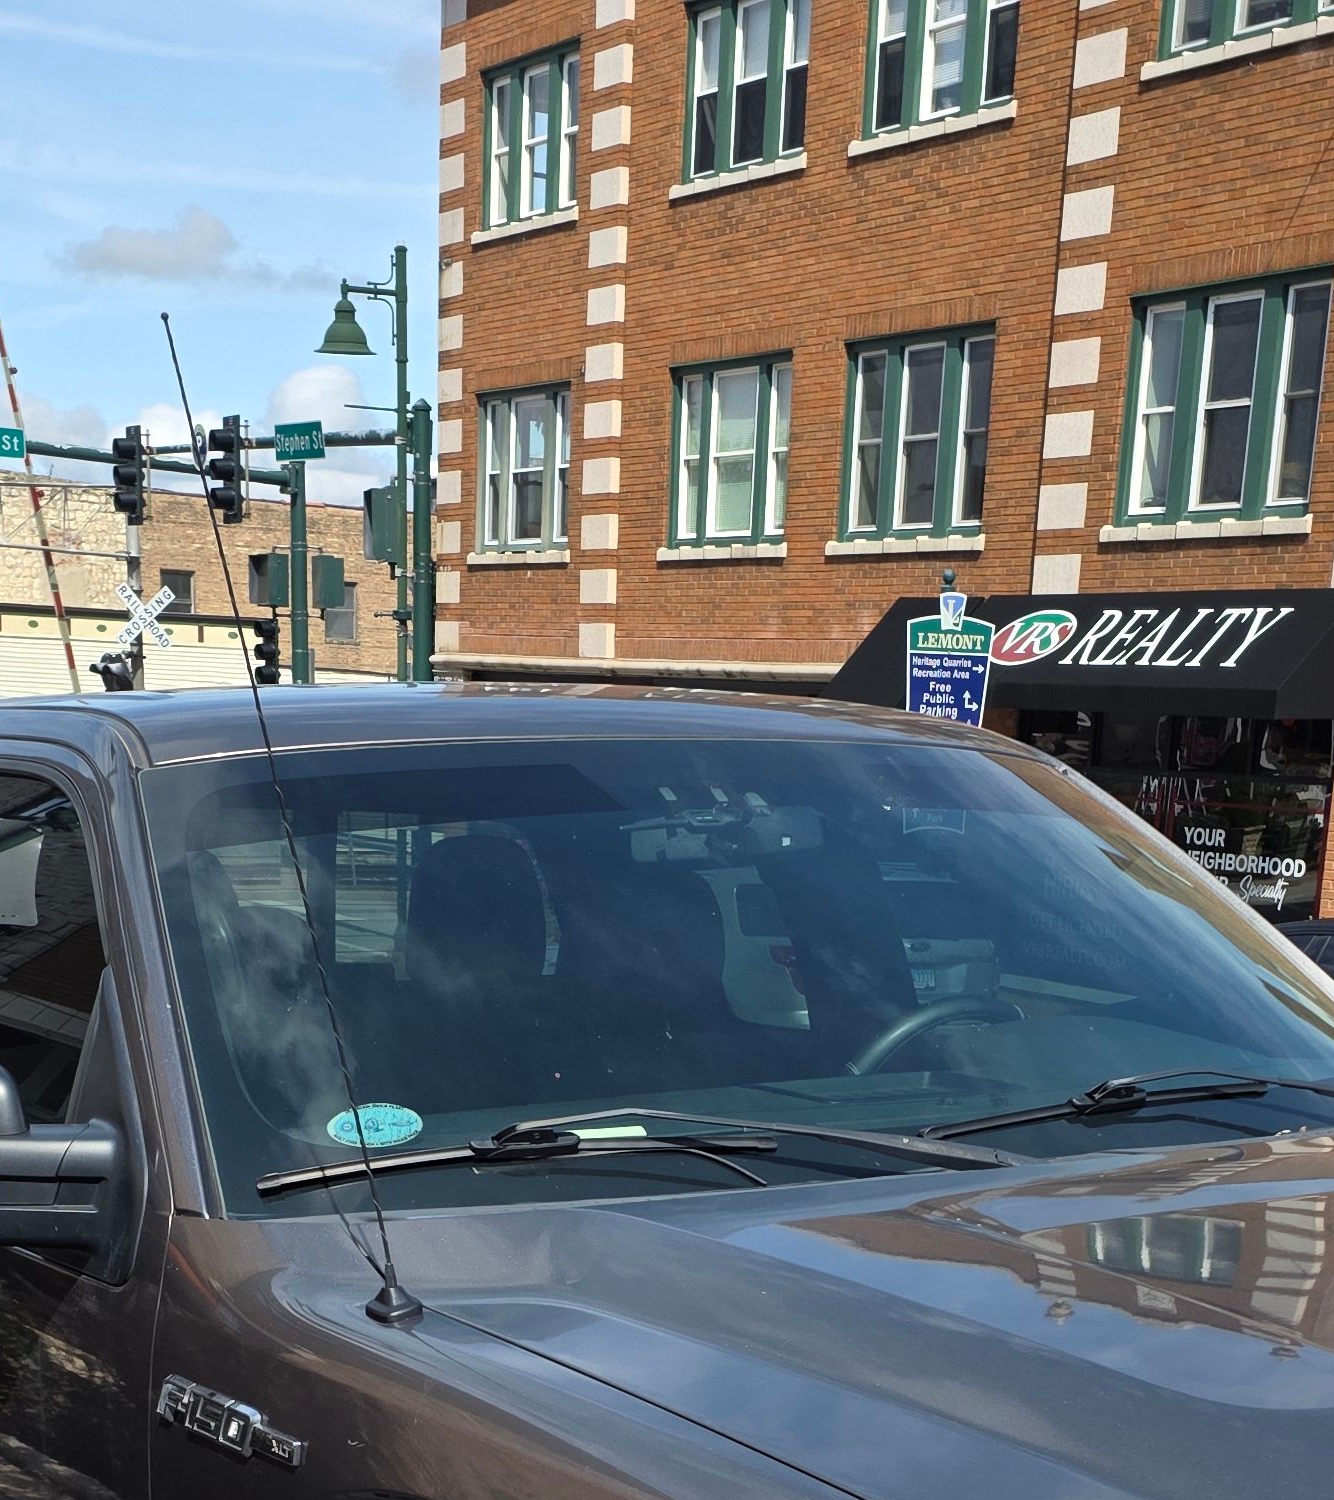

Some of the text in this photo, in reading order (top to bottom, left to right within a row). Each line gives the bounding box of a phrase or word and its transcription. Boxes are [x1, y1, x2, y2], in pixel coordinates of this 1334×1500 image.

[1, 434, 20, 452] St
[276, 432, 310, 455] Stephen
[118, 590, 172, 644] CROSSING
[917, 632, 985, 650] LEMONT
[1000, 607, 1295, 667] VRS REALTY
[912, 656, 972, 668] Heritage Quarries
[912, 667, 970, 679] Recreation Area
[929, 681, 952, 693] Free
[922, 692, 955, 704] Public
[919, 704, 958, 720] Parking
[1183, 826, 1226, 848] YOUR
[1235, 874, 1289, 911] Specialty
[270, 1439, 293, 1459] XLT
